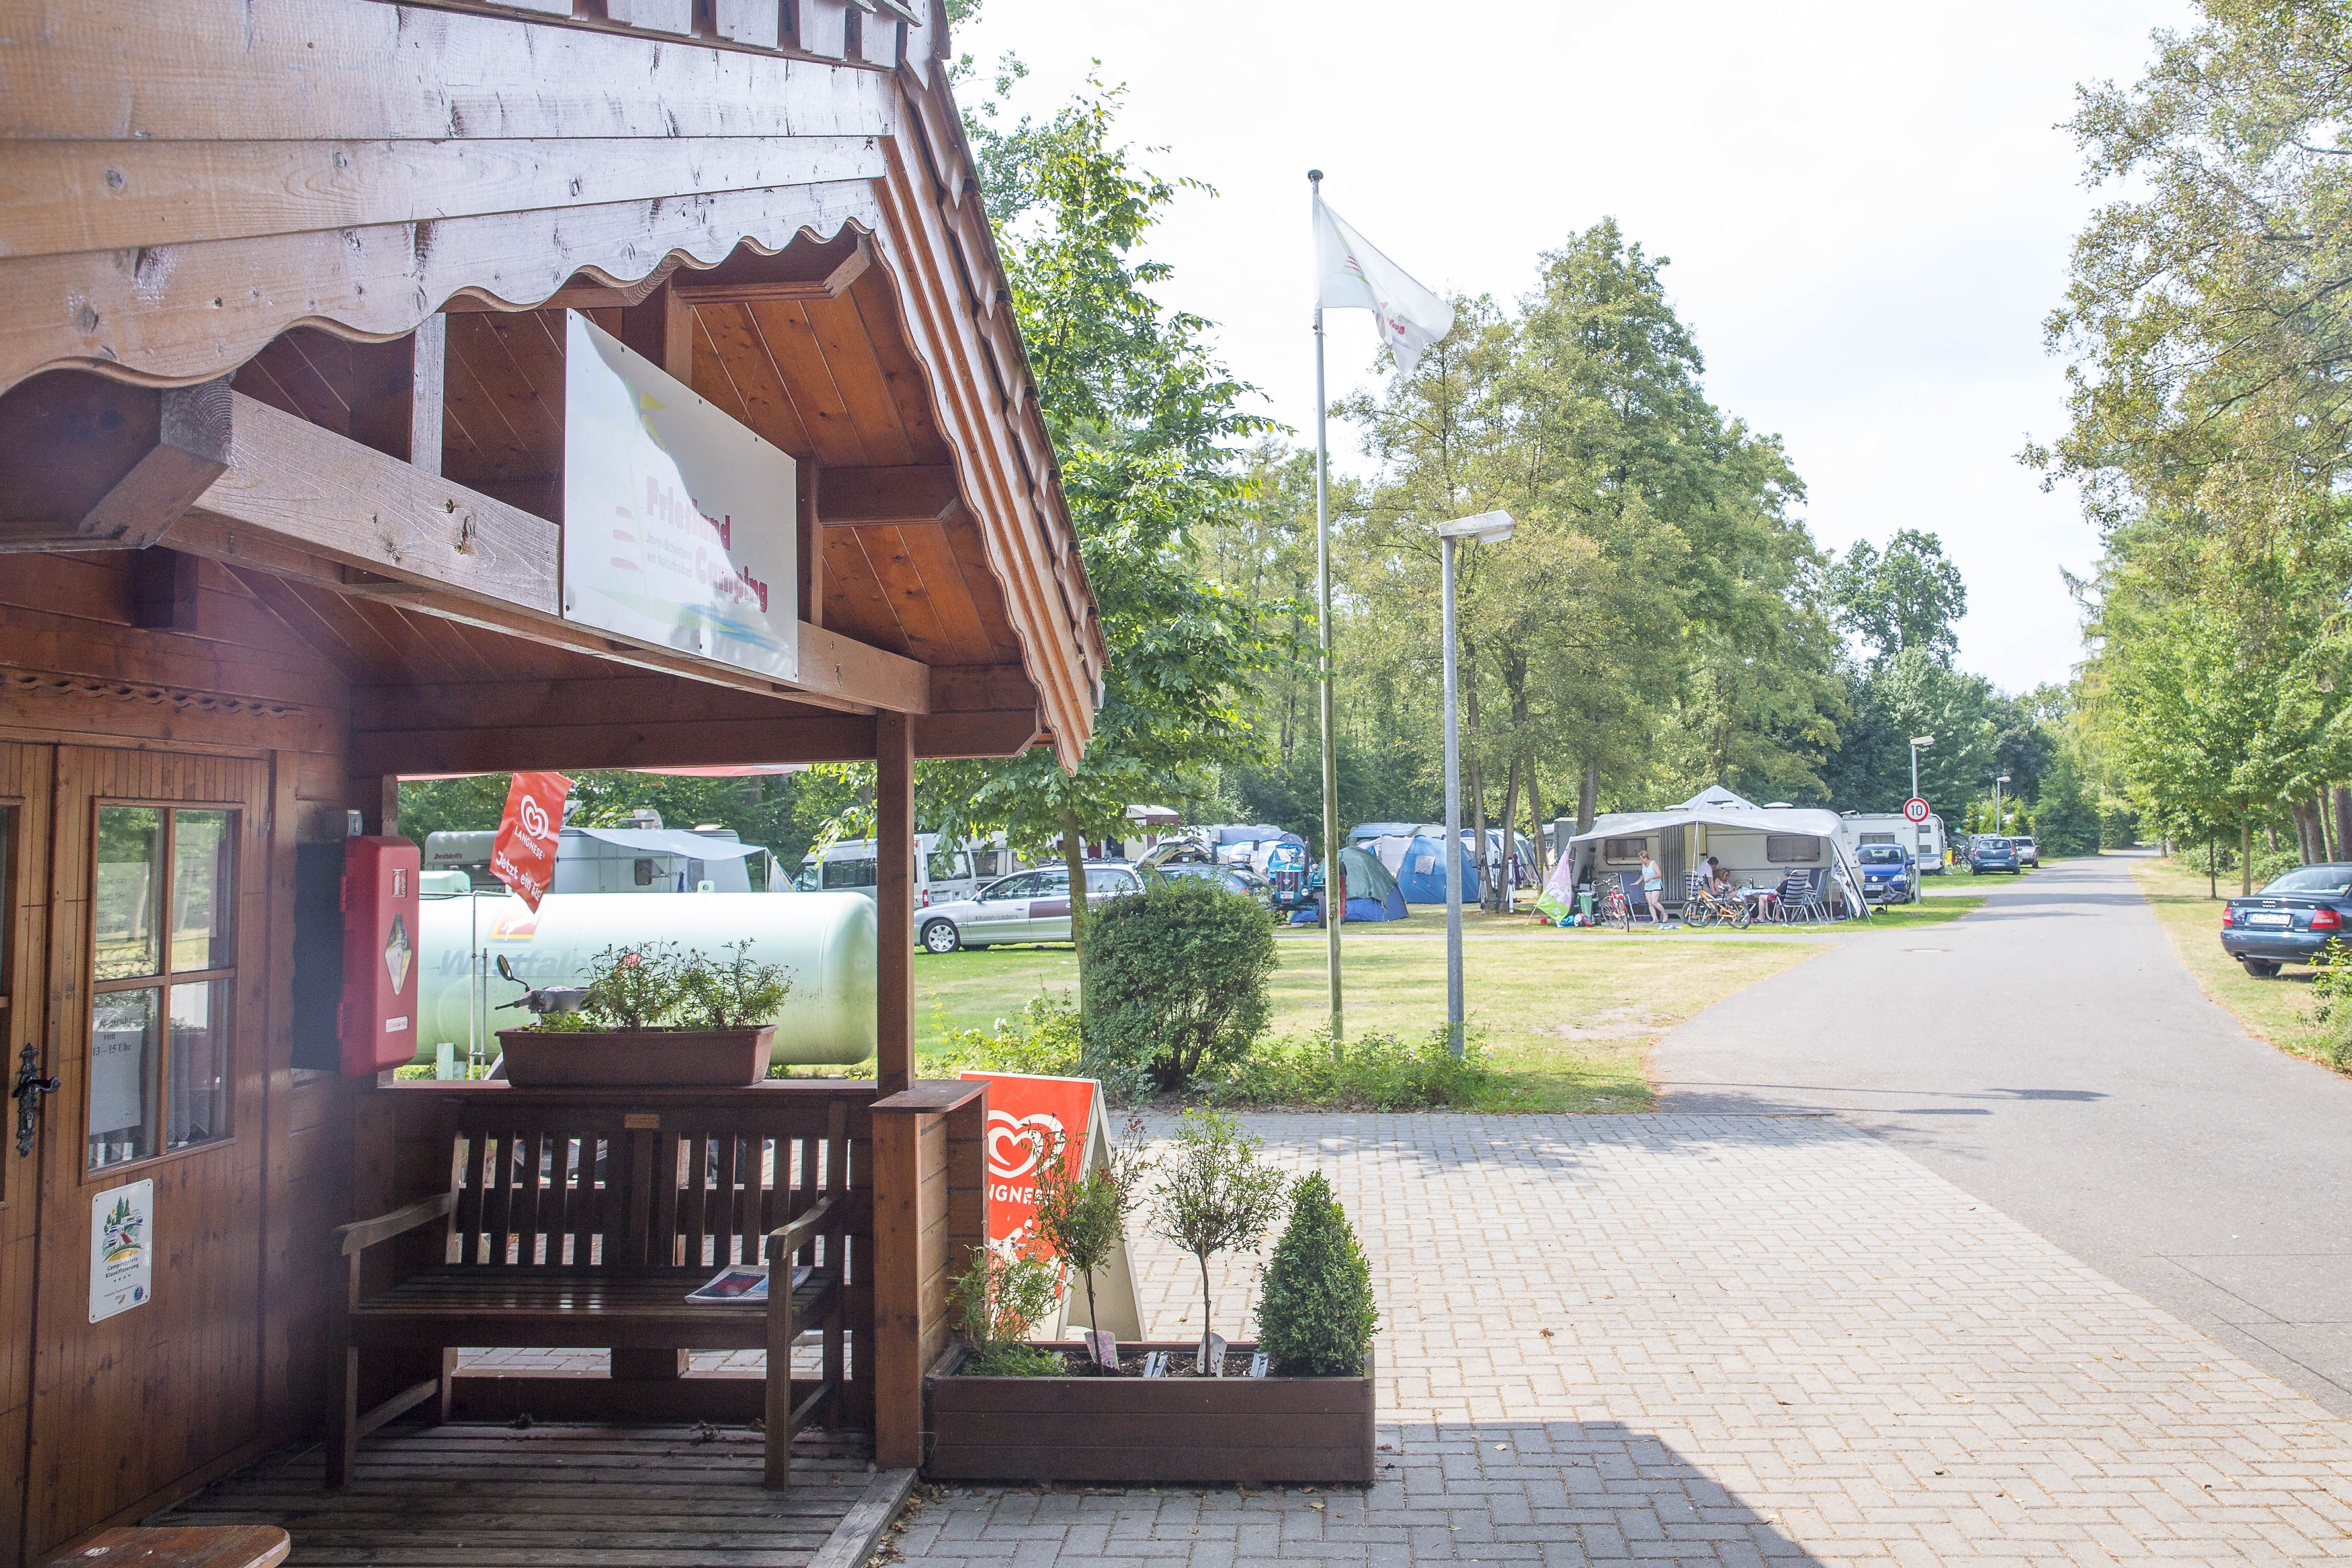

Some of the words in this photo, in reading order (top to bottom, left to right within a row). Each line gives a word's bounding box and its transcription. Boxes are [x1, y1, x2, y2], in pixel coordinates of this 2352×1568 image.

[647, 475, 730, 551] Friesland
[695, 546, 767, 613] Camping
[1911, 805, 1923, 816] 10
[514, 825, 544, 860] LANGNESE
[495, 850, 518, 880] Jetzt
[521, 872, 532, 891] ein
[531, 882, 544, 902] Eis!
